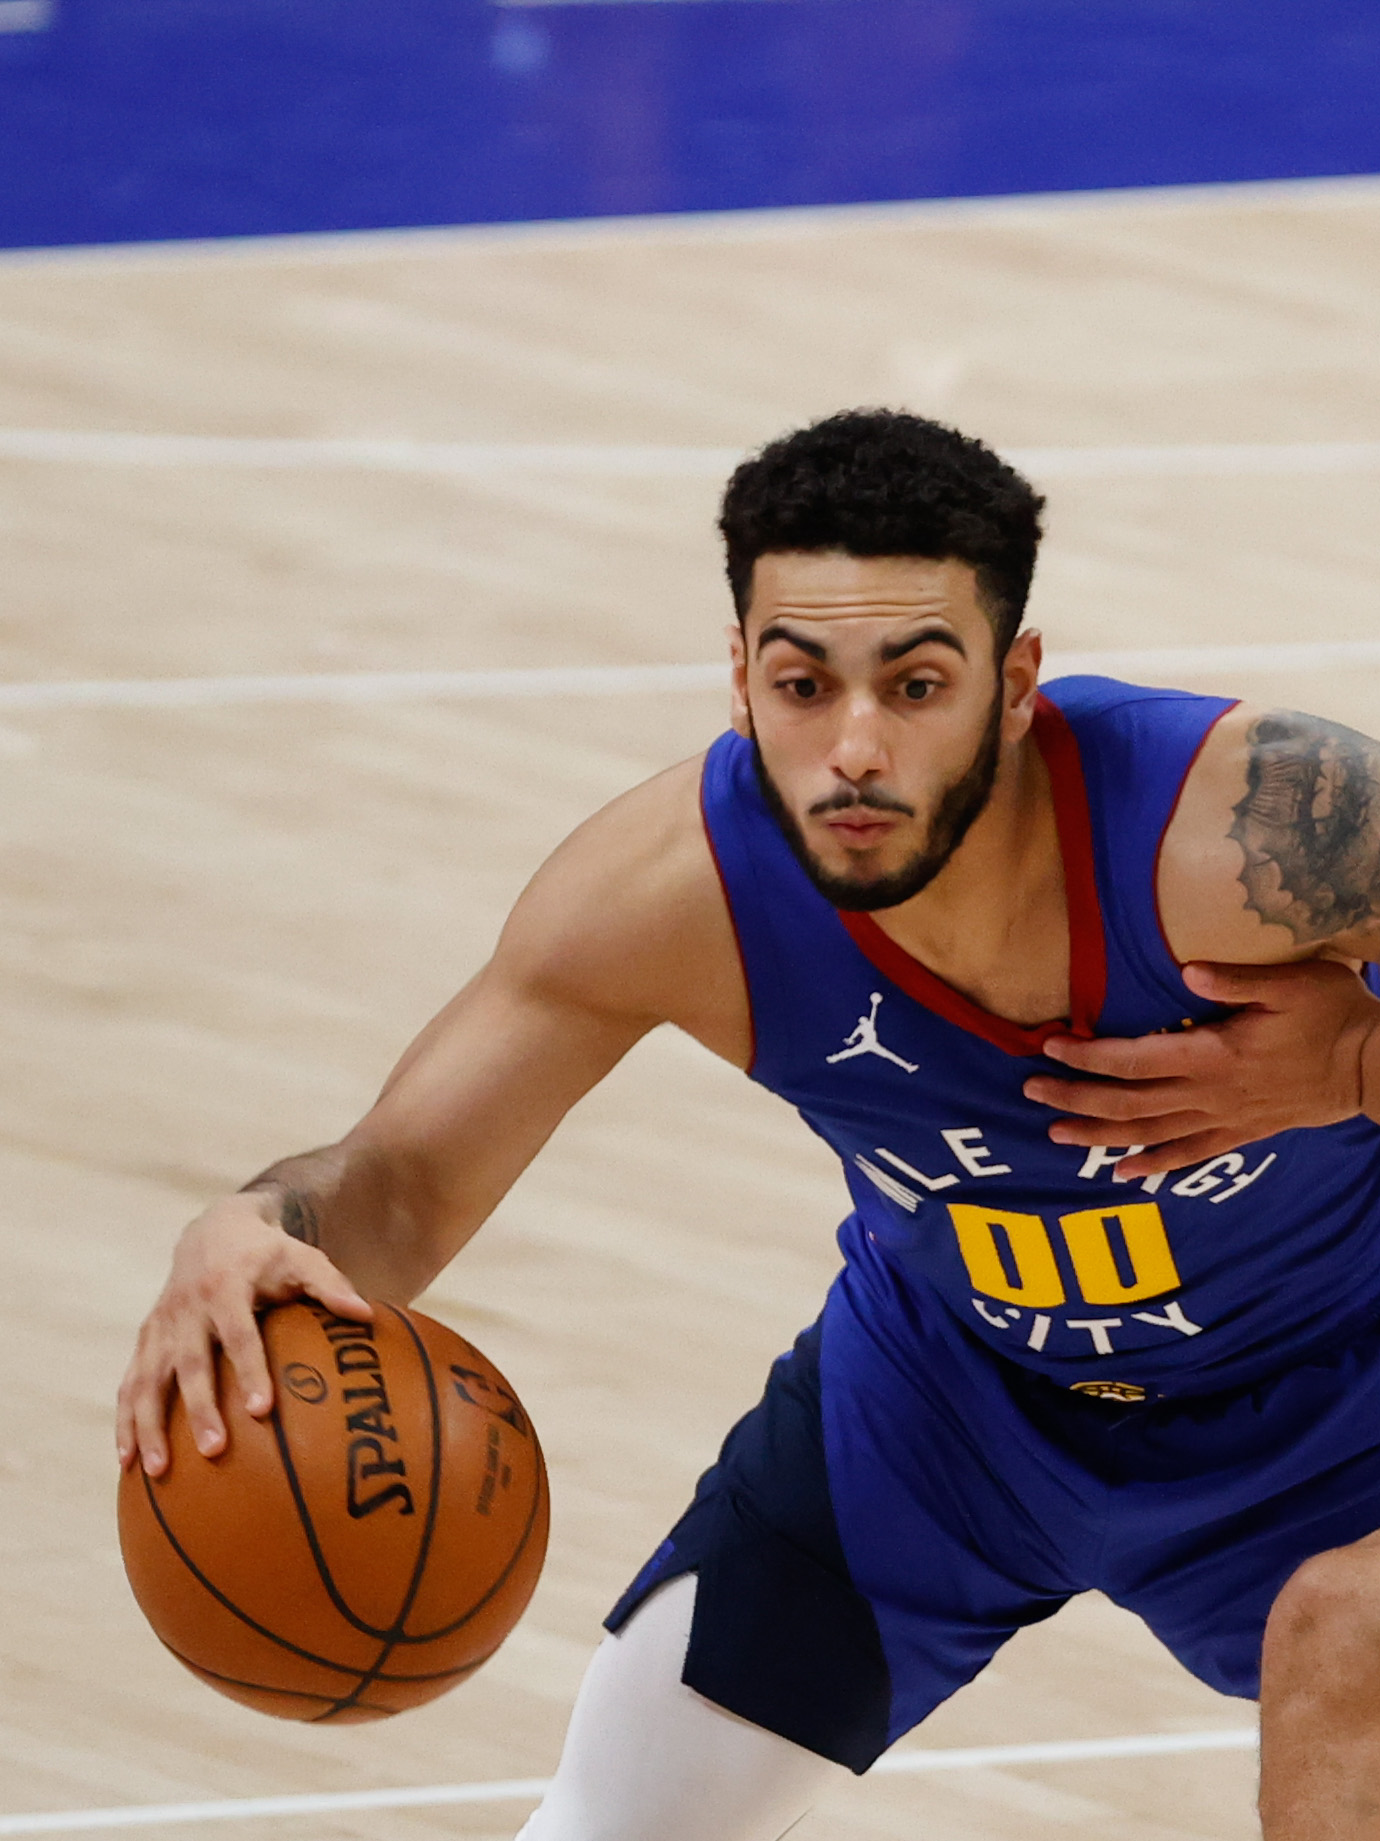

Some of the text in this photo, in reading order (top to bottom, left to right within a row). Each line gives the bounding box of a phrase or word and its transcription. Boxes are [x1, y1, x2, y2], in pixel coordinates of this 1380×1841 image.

[946, 1202, 1180, 1308] 00
[971, 1298, 1203, 1355] CITY
[314, 1312, 414, 1519] SPALDI
